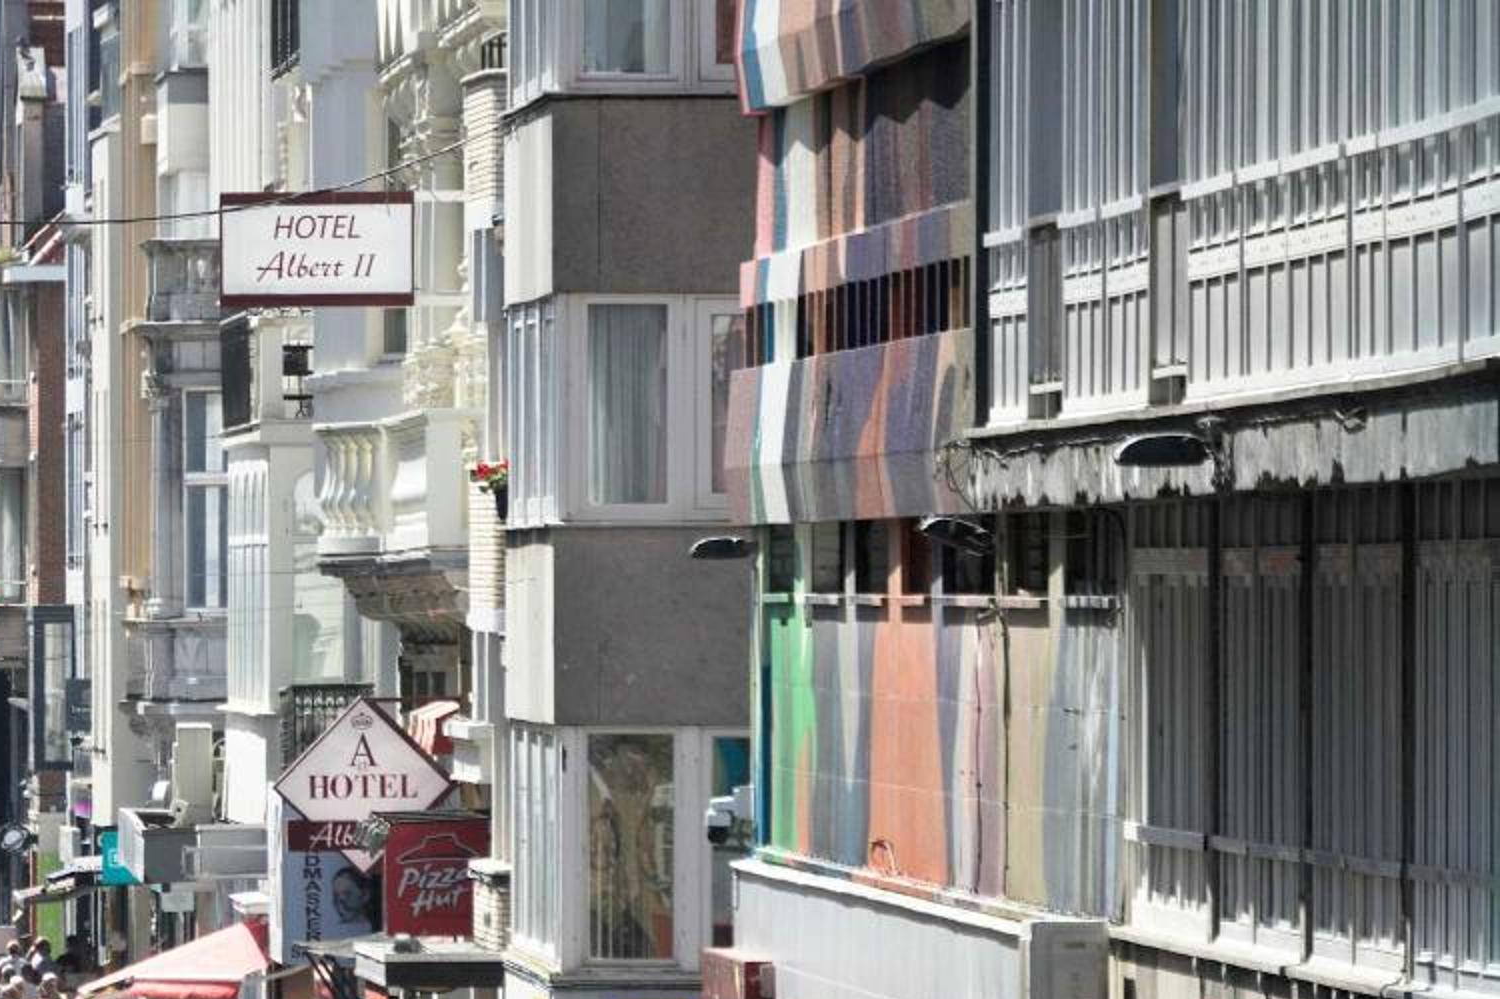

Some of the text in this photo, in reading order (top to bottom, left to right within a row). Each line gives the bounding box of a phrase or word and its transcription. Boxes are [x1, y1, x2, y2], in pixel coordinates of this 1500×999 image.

[273, 214, 362, 239] HOTEL
[256, 250, 344, 283] Albert
[350, 732, 377, 767] A
[309, 775, 418, 800] HOTEL
[410, 889, 462, 919] Hut
